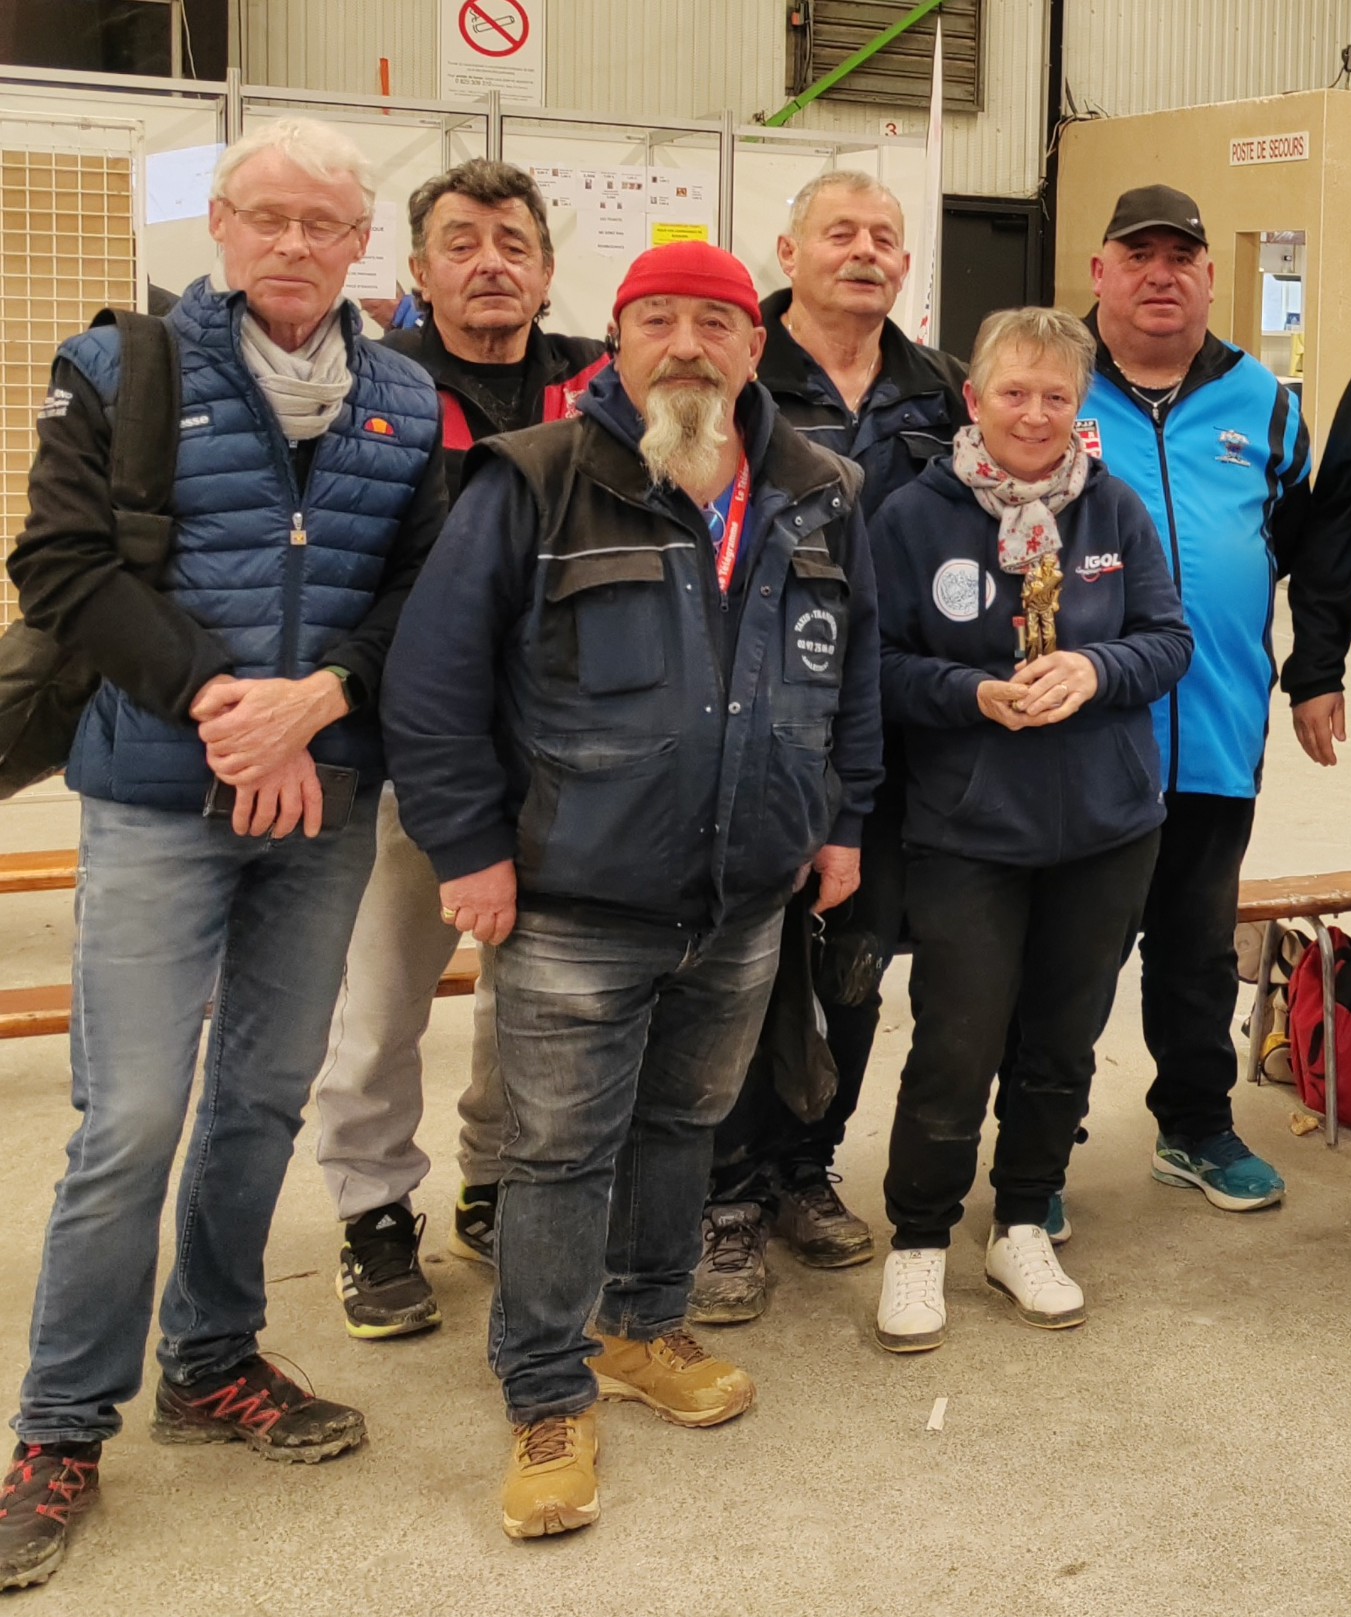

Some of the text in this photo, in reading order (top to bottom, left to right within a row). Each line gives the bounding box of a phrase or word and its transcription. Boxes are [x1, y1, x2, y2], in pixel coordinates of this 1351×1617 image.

[885, 122, 897, 135] 3
[1232, 136, 1304, 162] POSTE DE SECOURS
[719, 521, 738, 576] Télégramme
[1085, 553, 1121, 569] IGOL
